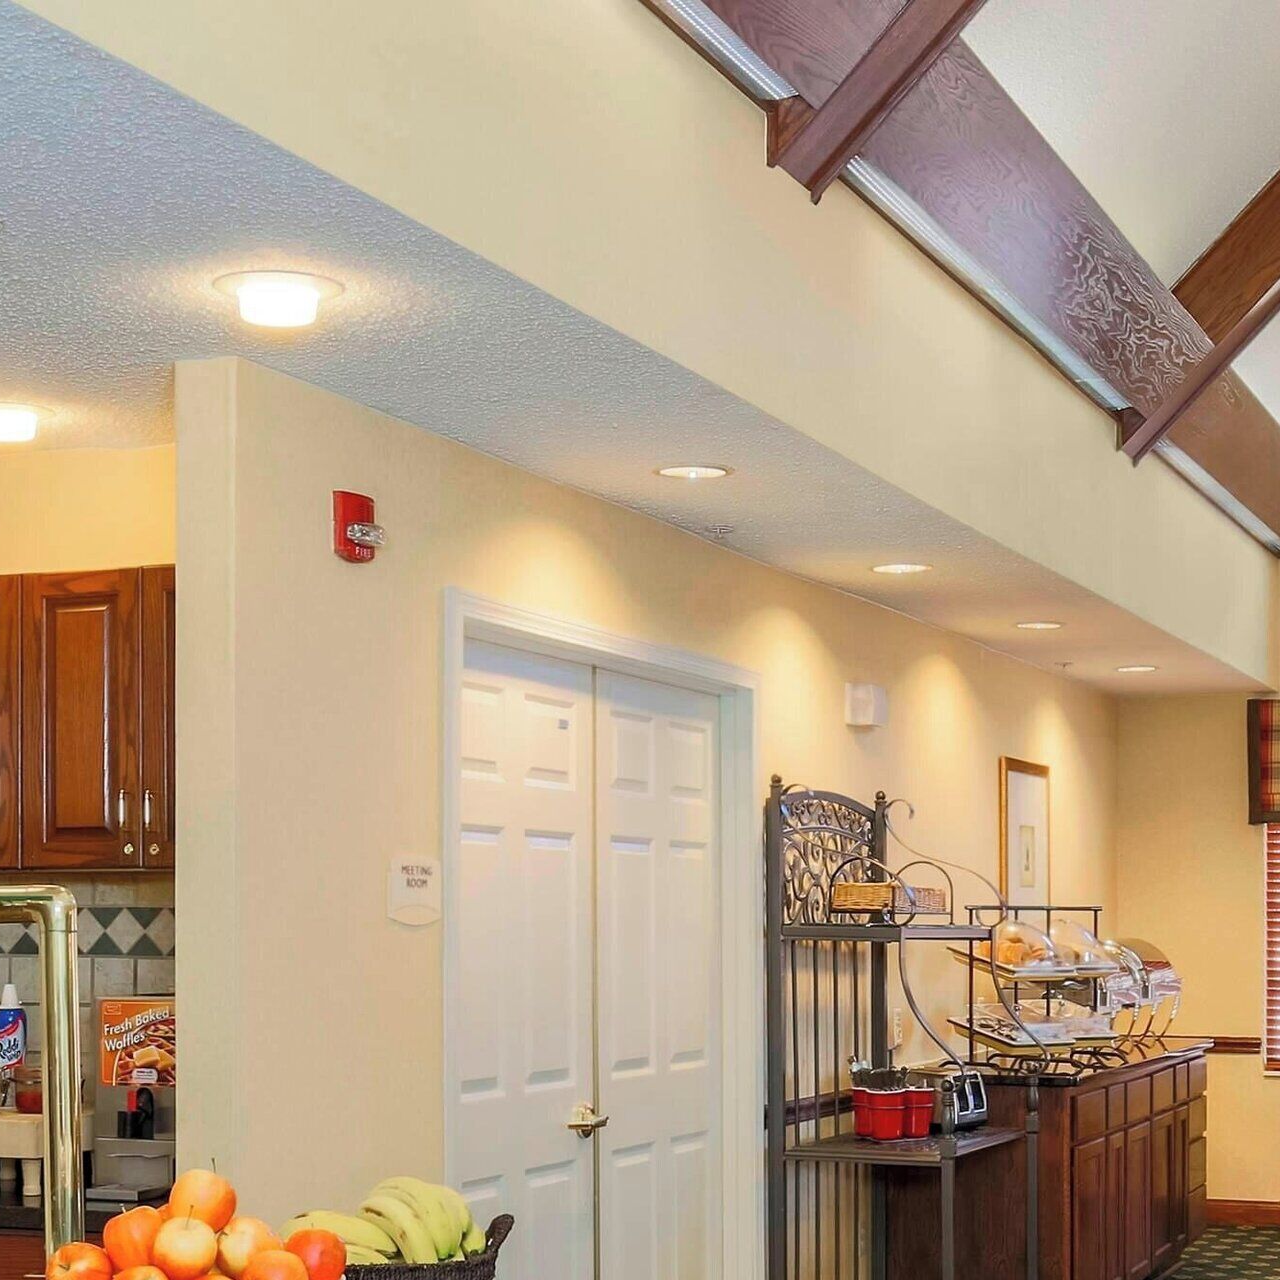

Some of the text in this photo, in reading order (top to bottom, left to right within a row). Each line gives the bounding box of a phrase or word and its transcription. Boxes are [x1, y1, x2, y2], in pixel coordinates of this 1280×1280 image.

[355, 546, 371, 558] FIRE
[401, 865, 432, 876] MEETING
[406, 877, 428, 888] ROOM
[104, 1018, 132, 1035] Fresh
[135, 1006, 169, 1026] Baked
[105, 1032, 145, 1051] Waffles
